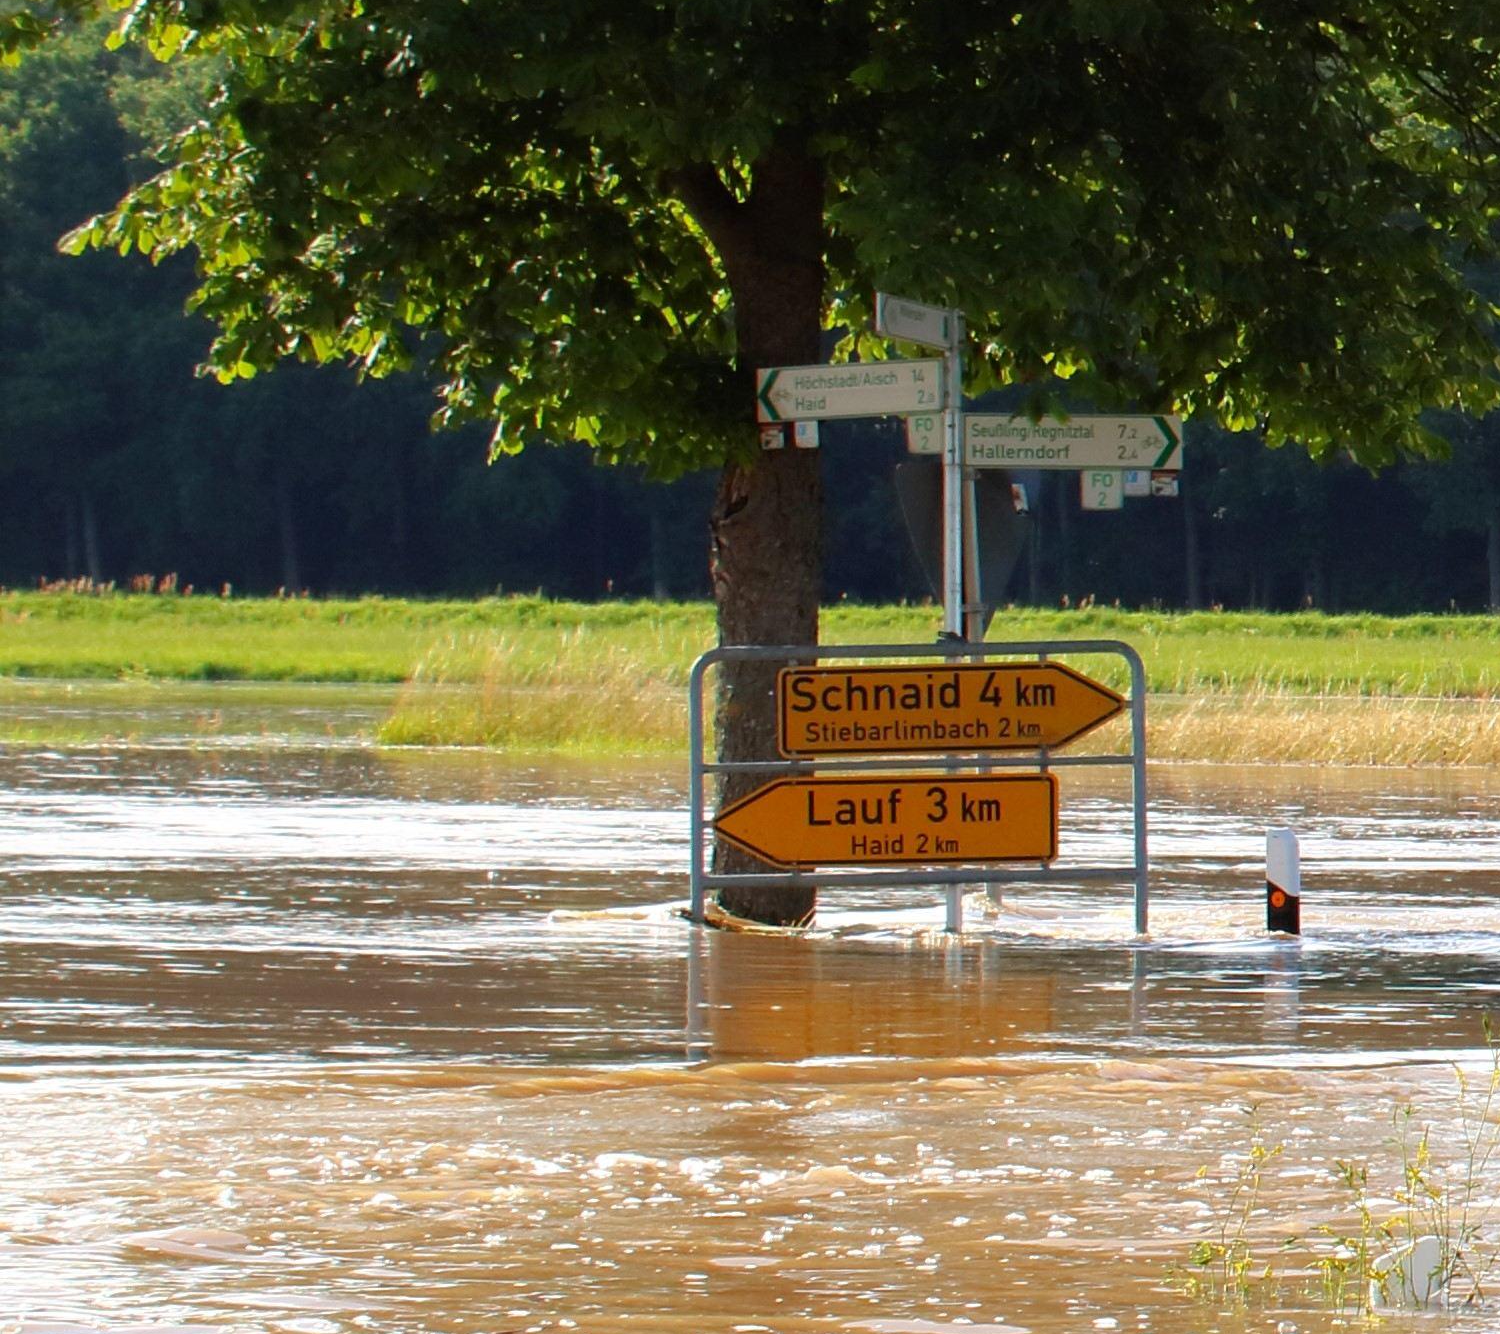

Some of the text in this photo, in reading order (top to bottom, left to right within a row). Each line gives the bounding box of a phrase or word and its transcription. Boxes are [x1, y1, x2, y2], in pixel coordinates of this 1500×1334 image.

[795, 369, 925, 390] Höchstadt/Aisch 14
[795, 397, 826, 411] Haid
[921, 436, 928, 450] 2
[971, 444, 1070, 459] Hallerndorf
[1098, 492, 1107, 507] 2
[791, 671, 1056, 713] Schnaid 4 km
[805, 717, 1041, 743] Stiebarlimbach 2 km
[807, 786, 1001, 826] Lauf 3 km
[851, 833, 959, 855] Haid 2 km
